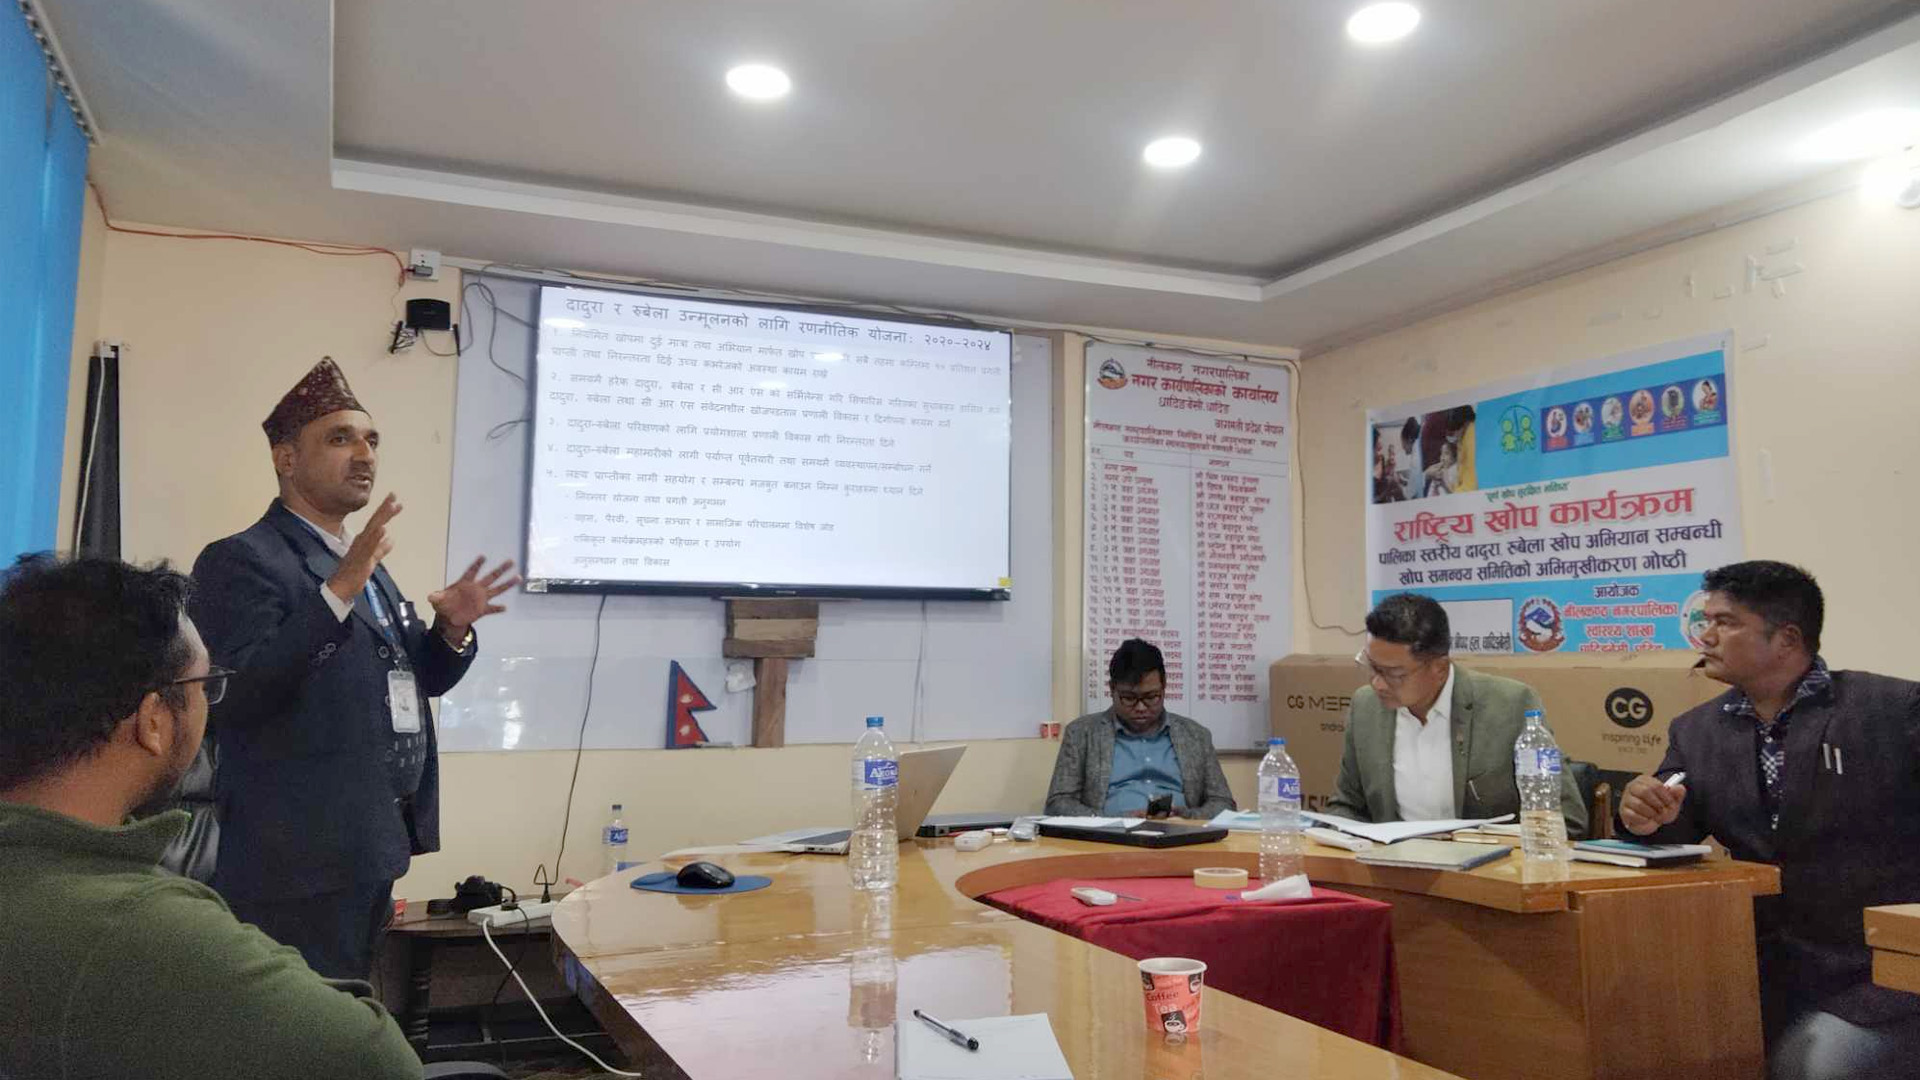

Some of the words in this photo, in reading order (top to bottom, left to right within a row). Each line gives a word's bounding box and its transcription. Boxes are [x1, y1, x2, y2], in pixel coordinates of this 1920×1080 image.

[614, 302, 622, 316] र
[758, 315, 789, 332] लागि
[1191, 364, 1250, 382] नगरपालिका
[1131, 373, 1158, 389] नगर
[1231, 384, 1279, 405] कार्यालय
[1394, 511, 1474, 543] राष्ट्रिय
[1484, 502, 1539, 533] खोप
[1549, 488, 1695, 525] कार्यक्रम
[1378, 547, 1416, 565] पालिका
[1420, 544, 1461, 563] स्तरीय
[1550, 532, 1580, 552] खोप
[1585, 528, 1649, 549] अभियान
[1655, 518, 1723, 545] सम्बन्धी
[1398, 568, 1423, 586] खोप
[1427, 568, 1472, 584] समन्वय
[1477, 561, 1531, 582] समितिको
[1536, 555, 1637, 578] अभिमुखीकरण
[1643, 549, 1688, 570] गोष्ठी
[1594, 583, 1641, 598] आयोजक
[1614, 599, 1679, 617] नगरपालिका
[1287, 694, 1305, 710] CG
[1611, 697, 1647, 719] CG
